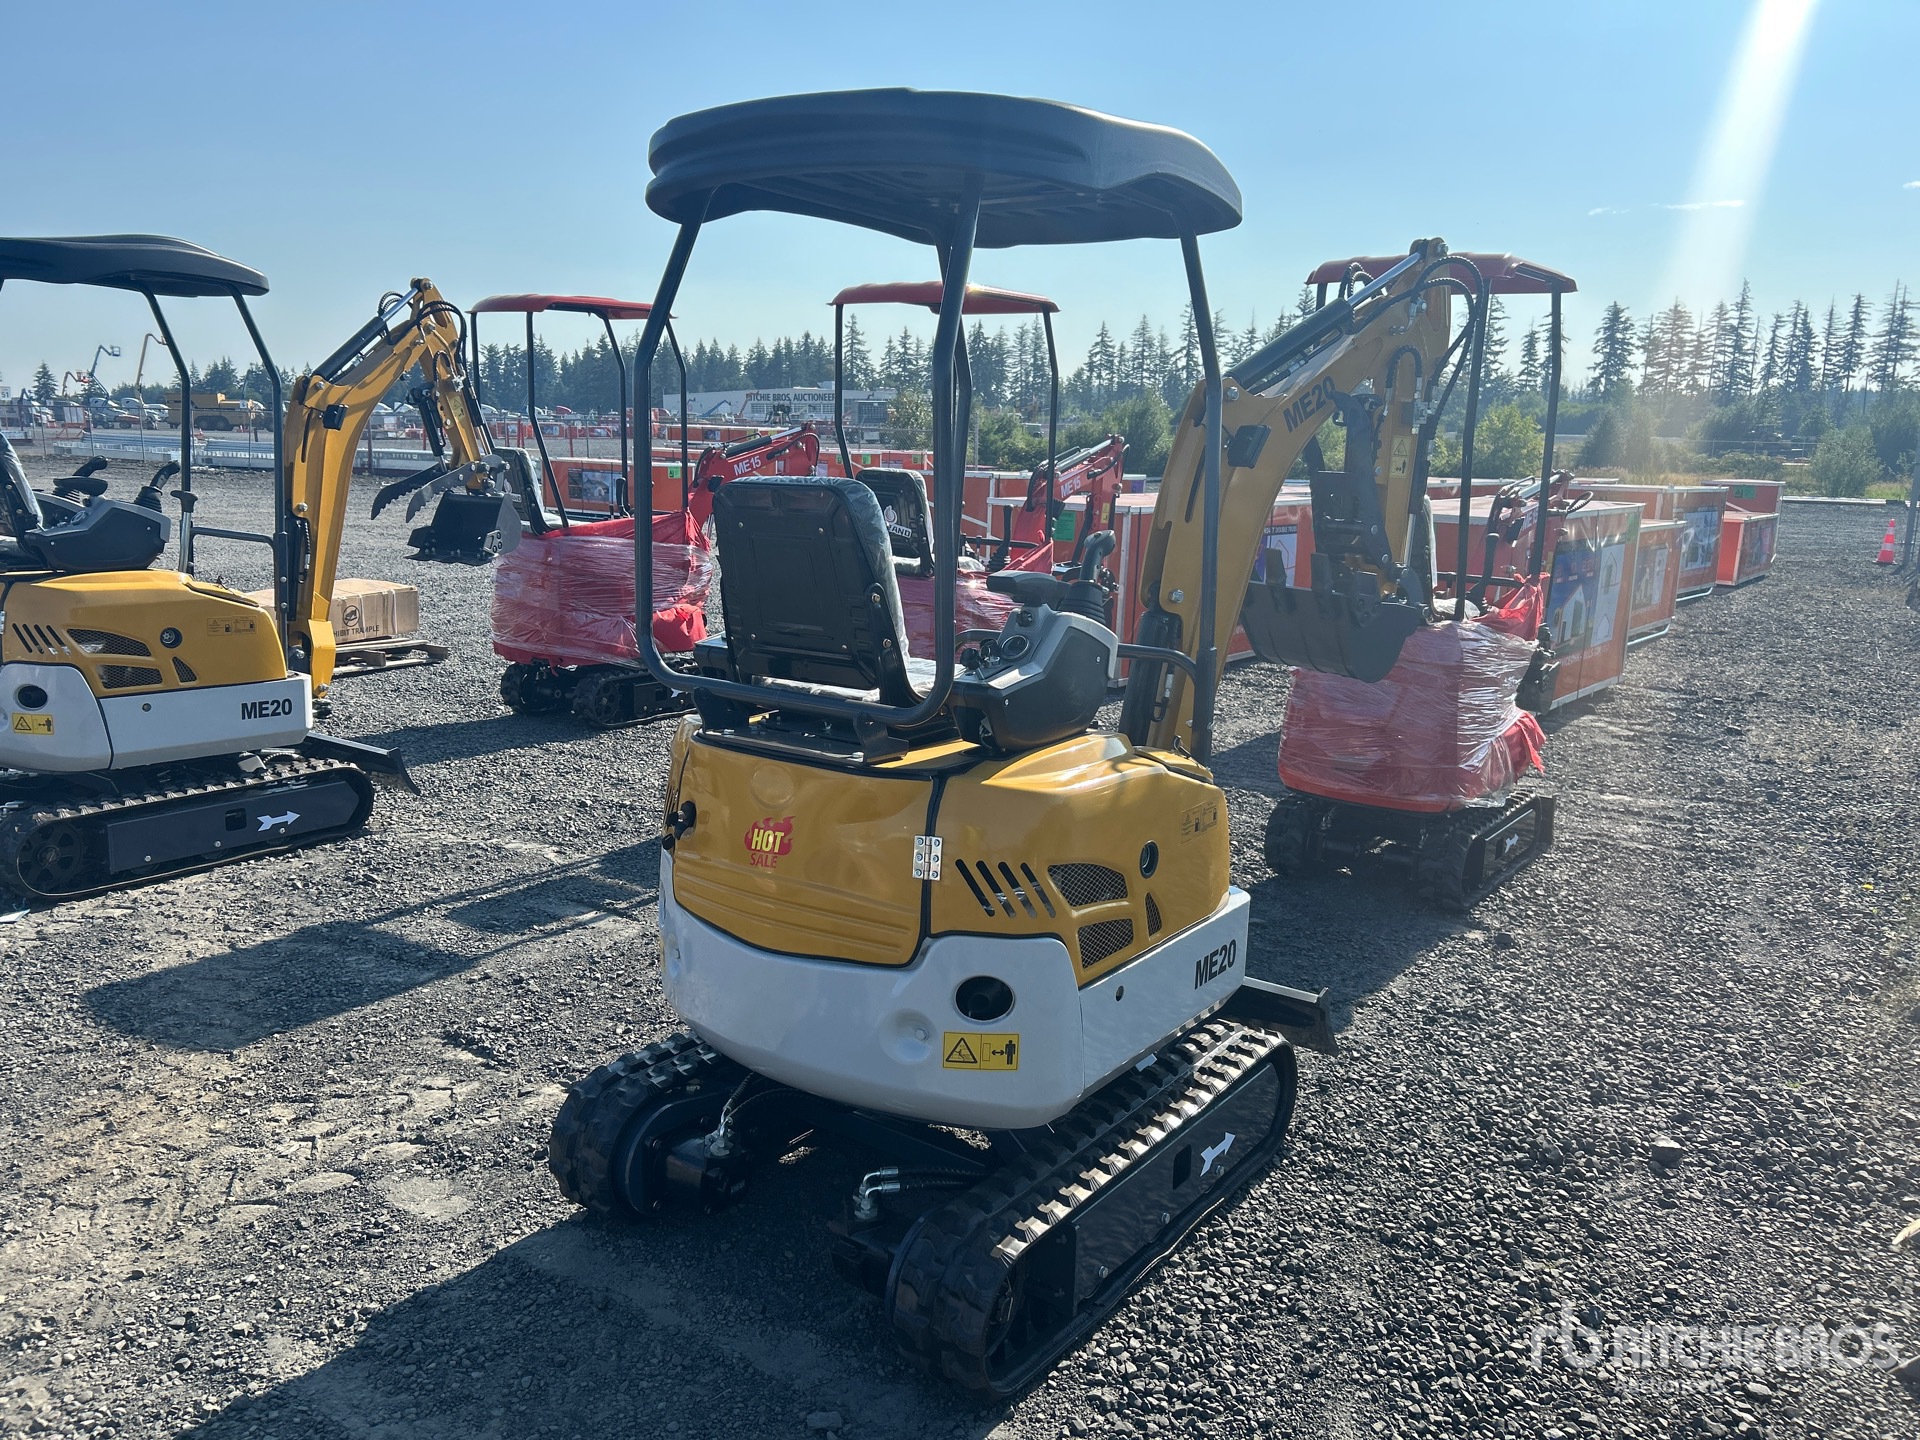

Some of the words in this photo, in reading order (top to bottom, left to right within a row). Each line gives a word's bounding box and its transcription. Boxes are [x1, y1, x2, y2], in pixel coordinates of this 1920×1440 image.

[1283, 376, 1336, 432] ME20
[733, 455, 762, 476] ME15
[241, 698, 293, 720] ME20
[751, 828, 785, 853] HOT
[749, 852, 778, 868] SALE
[1194, 938, 1237, 990] ME20
